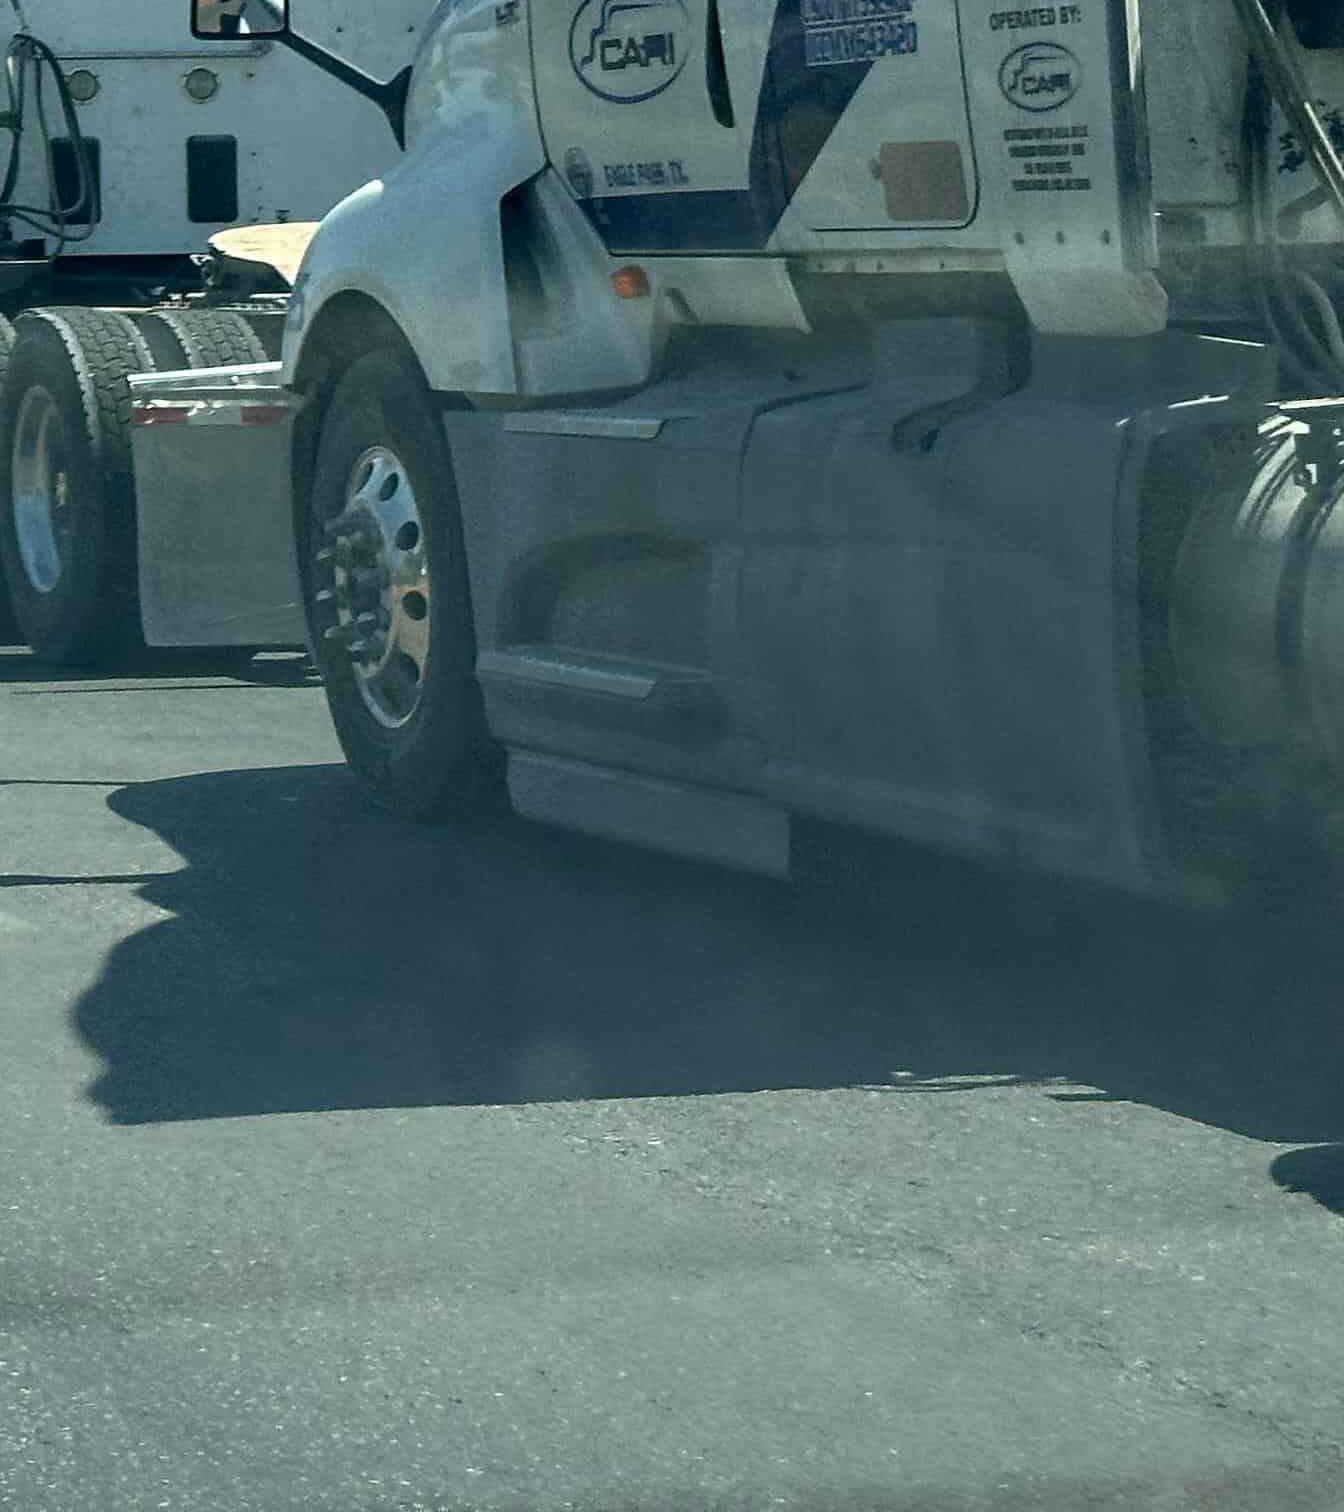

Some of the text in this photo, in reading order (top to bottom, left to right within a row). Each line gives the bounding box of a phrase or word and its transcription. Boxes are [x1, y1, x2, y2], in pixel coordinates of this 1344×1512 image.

[989, 4, 1082, 31] OPERATED BY:
[600, 32, 675, 72] CARI
[1021, 73, 1072, 95] CARI
